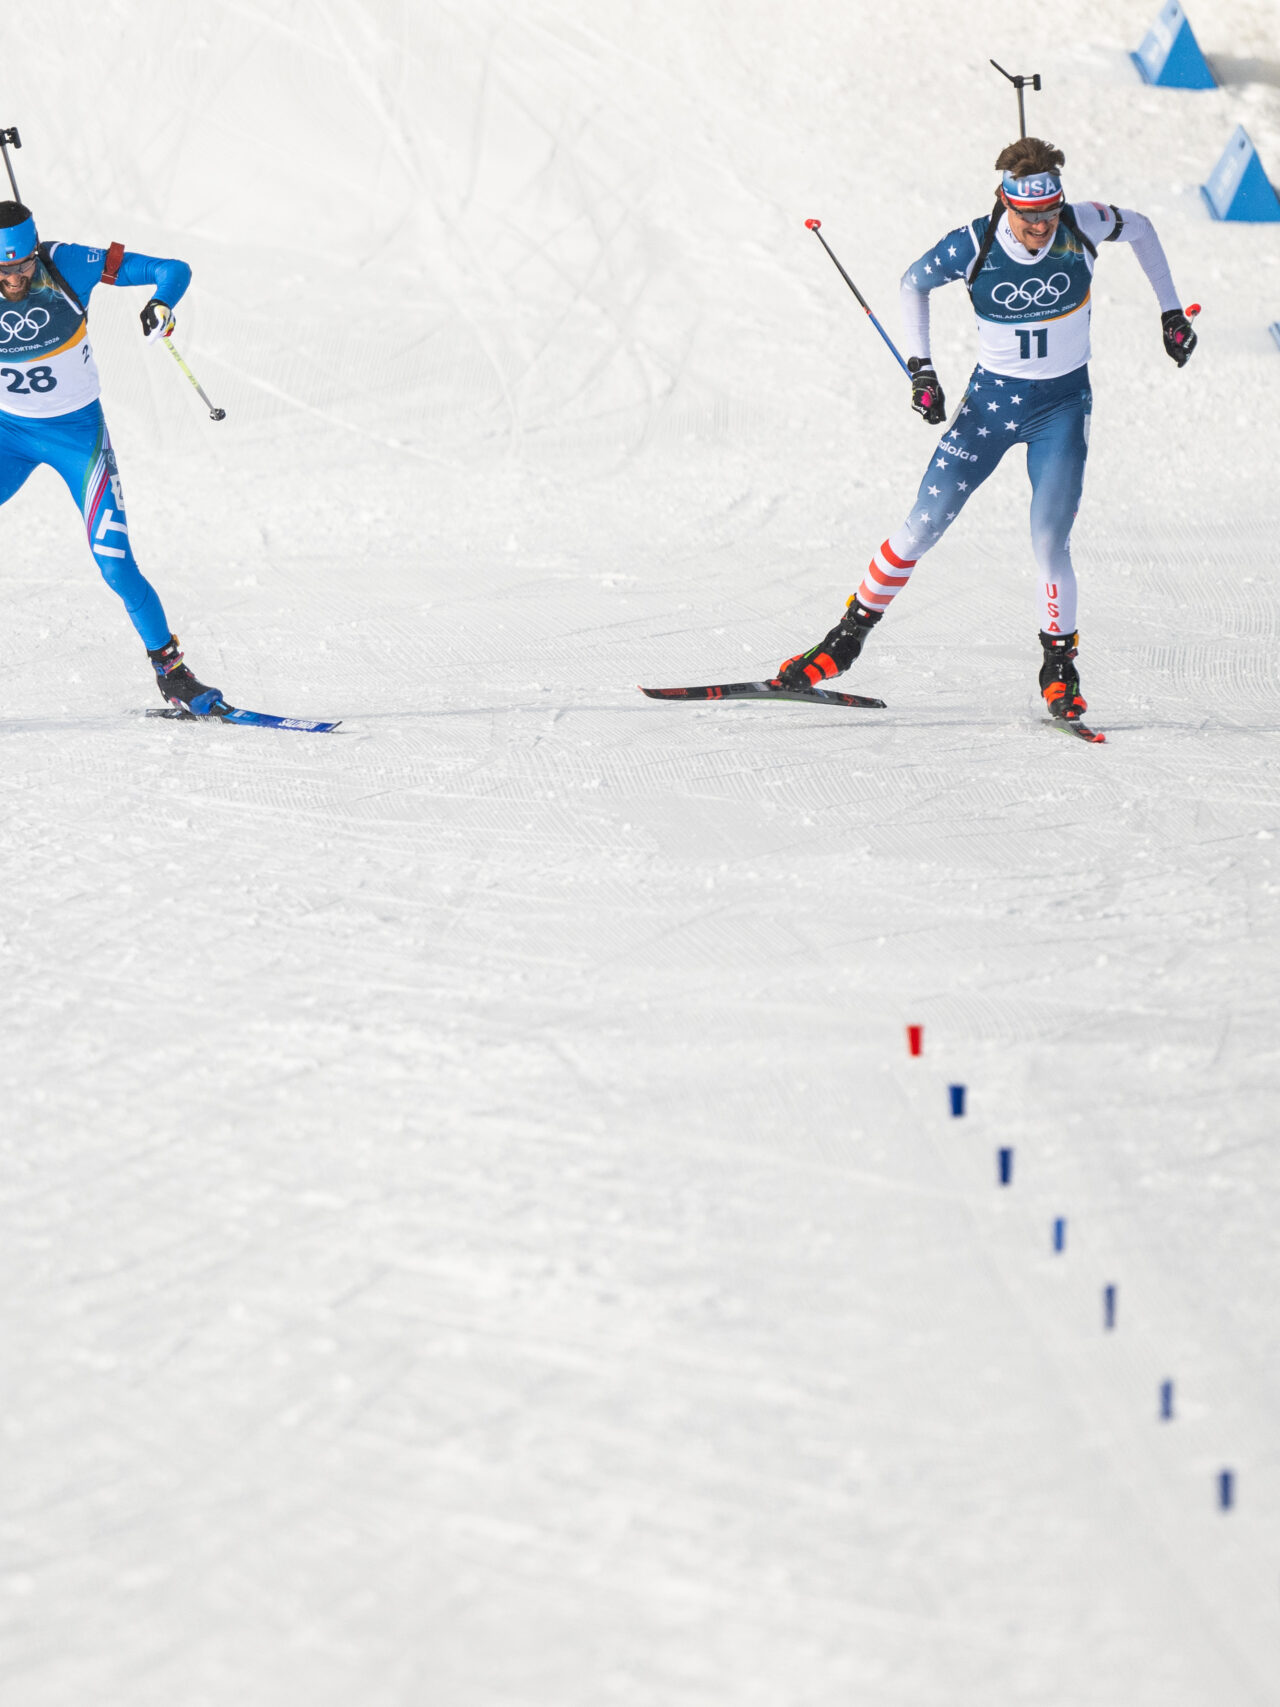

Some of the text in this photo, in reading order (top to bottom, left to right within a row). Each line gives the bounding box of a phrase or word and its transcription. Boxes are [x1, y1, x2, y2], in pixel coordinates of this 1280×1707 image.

[1017, 178, 1057, 197] USA
[988, 311, 1023, 320] MILANO
[1023, 308, 1060, 319] CORTINA
[9, 344, 43, 353] CORTINA
[44, 336, 60, 347] 2026
[1015, 328, 1048, 360] 11
[0, 365, 58, 395] 28
[1046, 583, 1061, 632] USA
